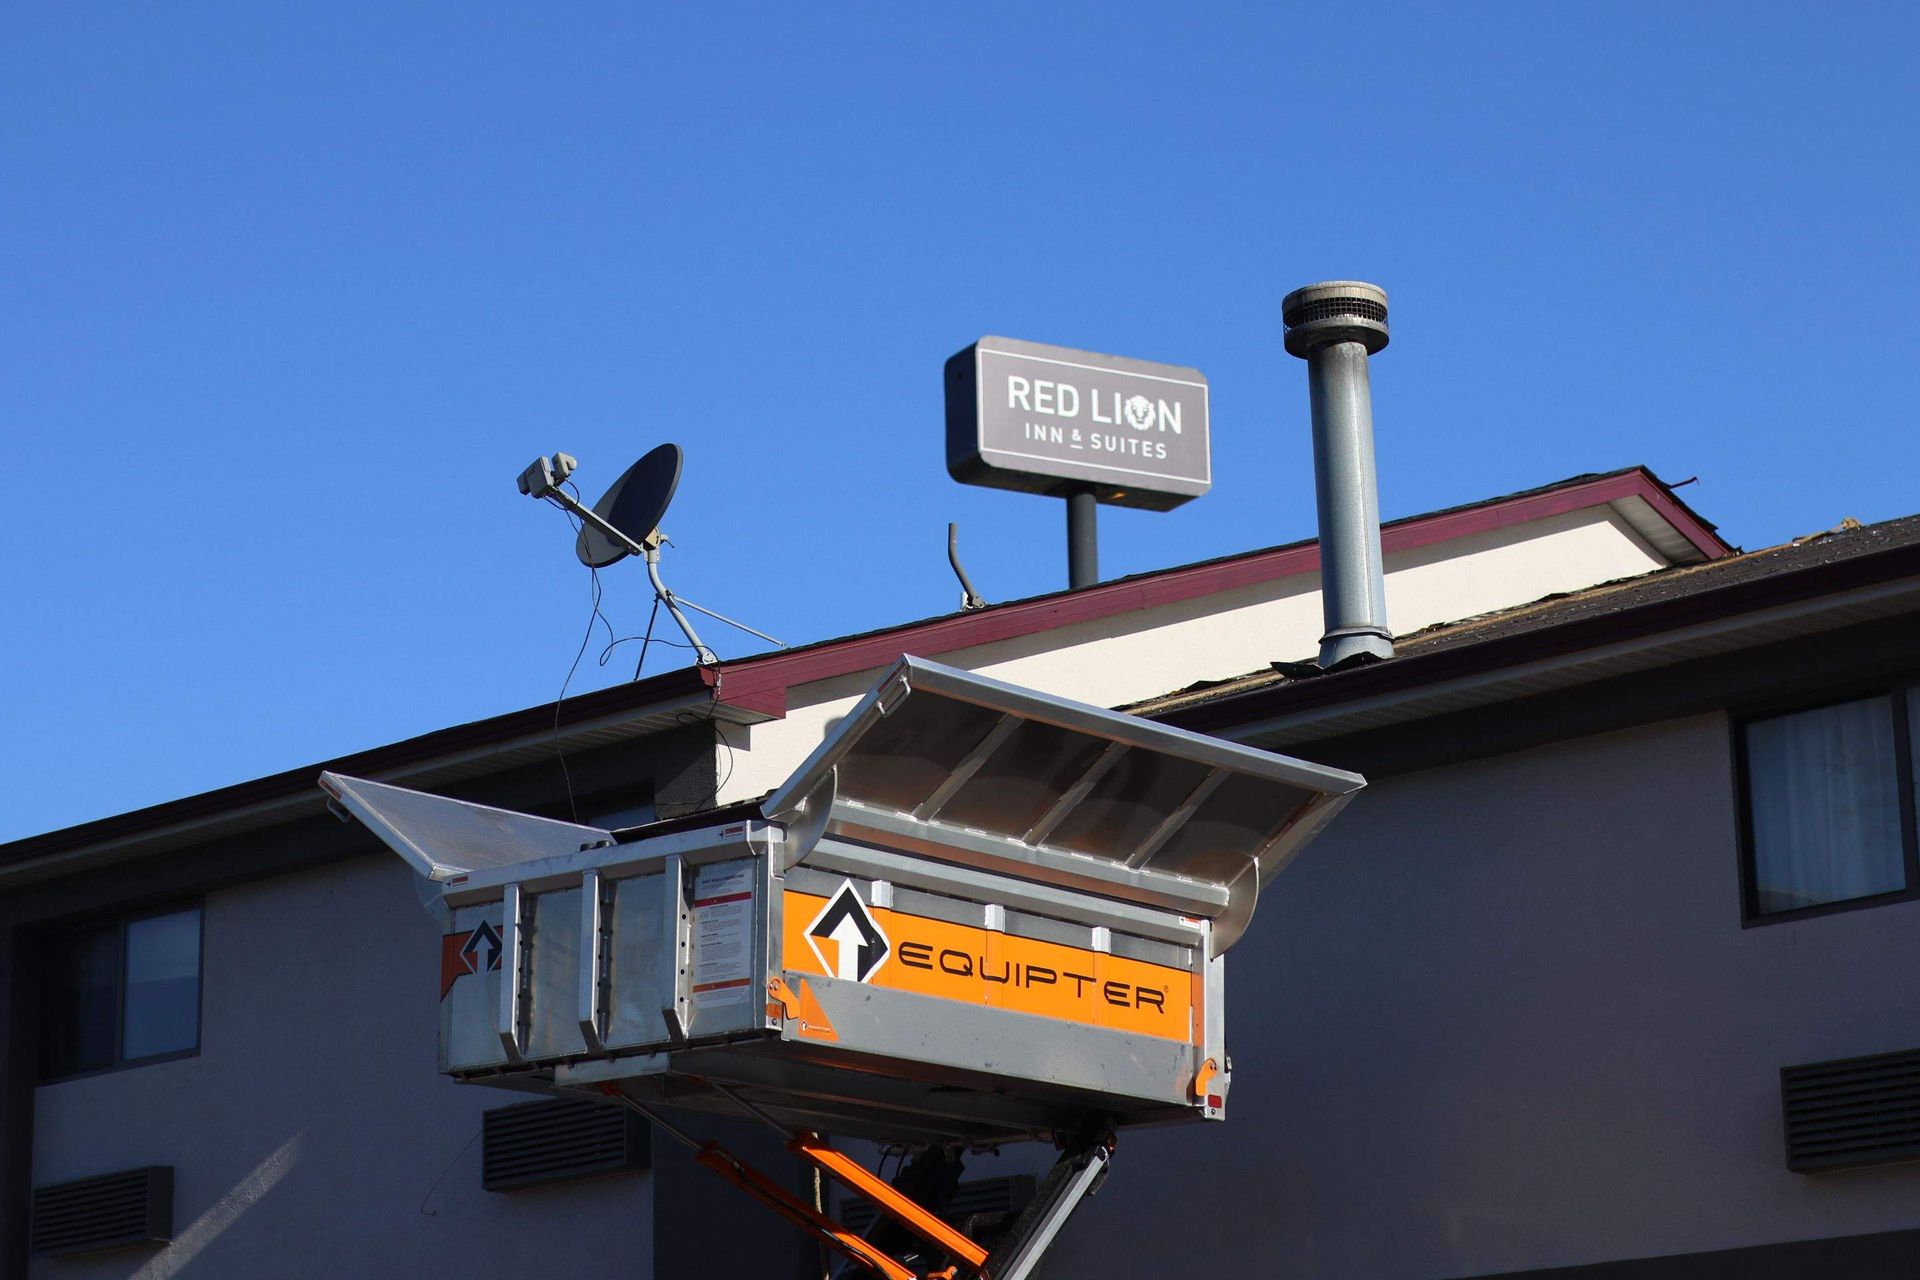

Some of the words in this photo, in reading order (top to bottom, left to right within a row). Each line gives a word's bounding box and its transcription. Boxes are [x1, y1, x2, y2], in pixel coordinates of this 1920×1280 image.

[1007, 375, 1080, 418] RED
[1025, 422, 1064, 444] INN
[1071, 428, 1083, 445] &
[1090, 433, 1167, 460] SUITES
[898, 941, 1166, 1014] EQUIPTER
